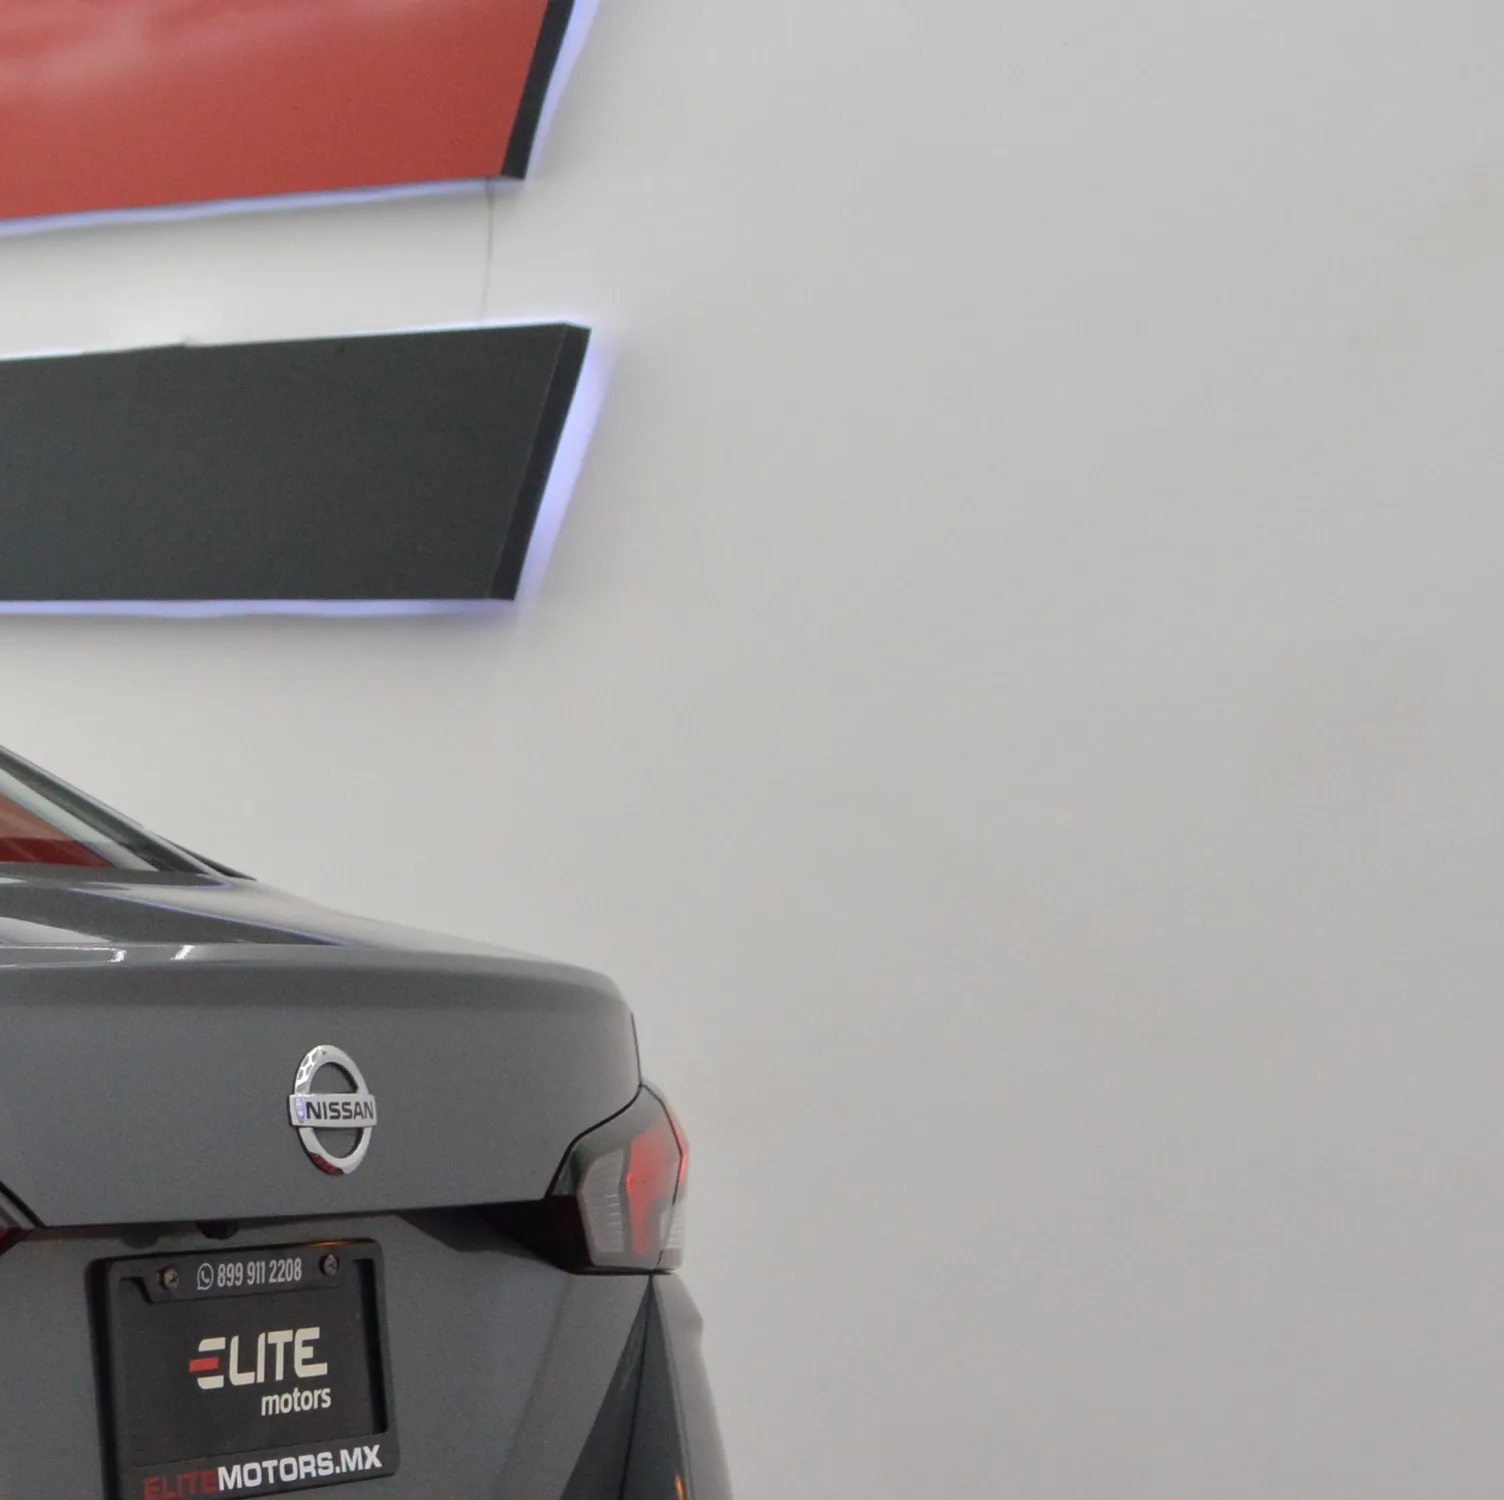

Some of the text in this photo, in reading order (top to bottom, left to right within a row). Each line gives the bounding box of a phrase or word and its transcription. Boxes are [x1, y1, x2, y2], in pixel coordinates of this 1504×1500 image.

[305, 1101, 374, 1120] NISSAN
[217, 1257, 302, 1287] 899 911 2208
[189, 1327, 328, 1390] ELITE
[261, 1386, 332, 1416] motors
